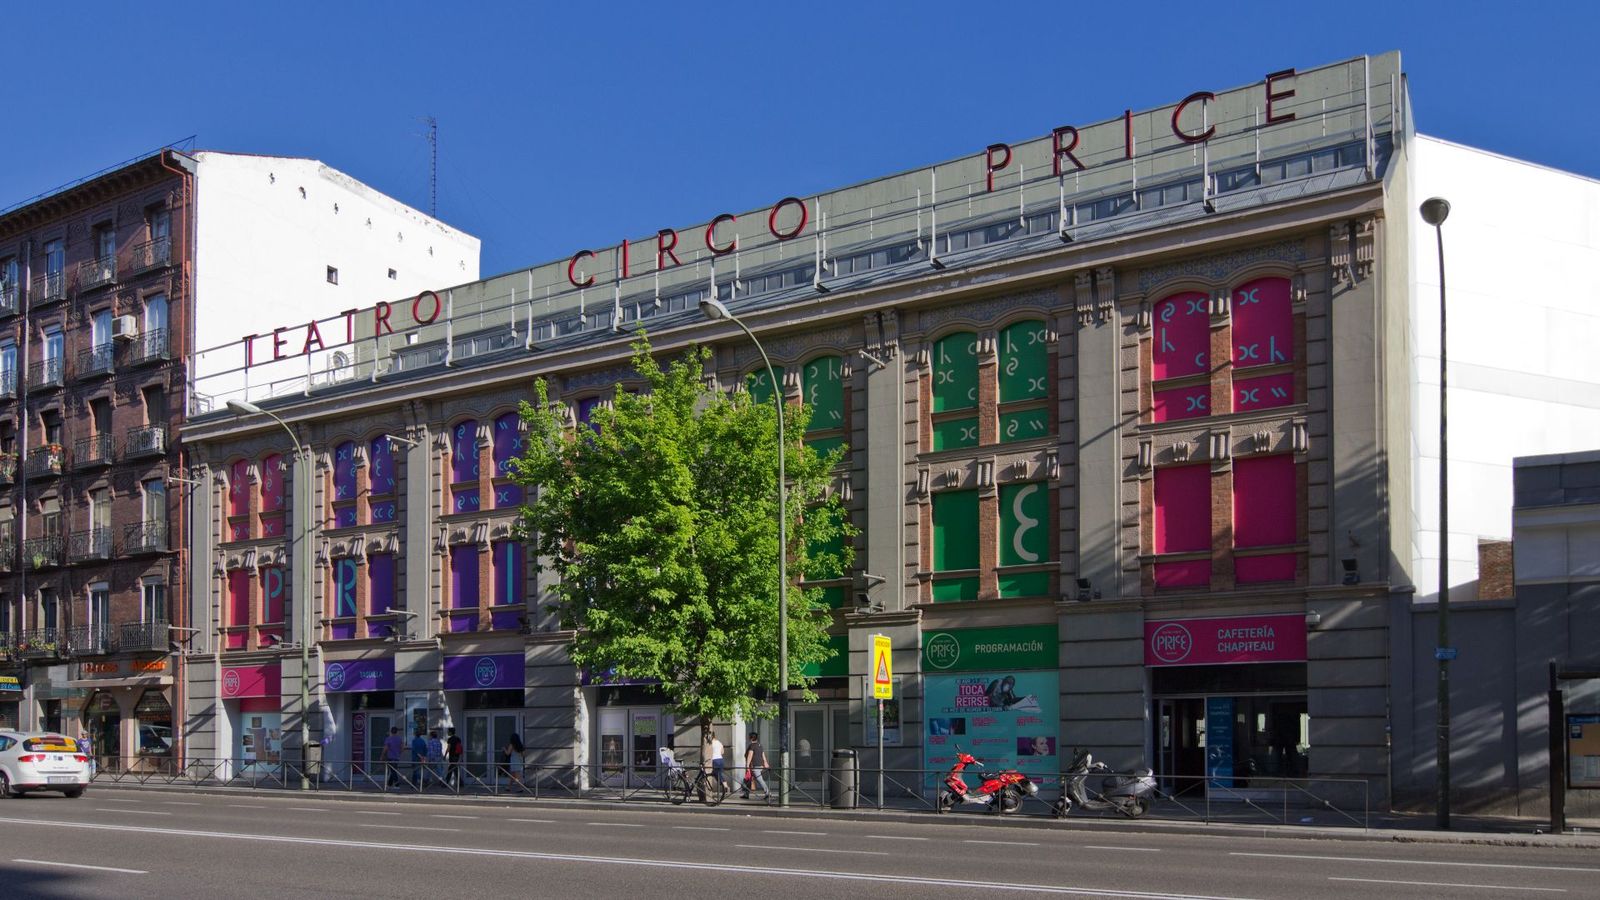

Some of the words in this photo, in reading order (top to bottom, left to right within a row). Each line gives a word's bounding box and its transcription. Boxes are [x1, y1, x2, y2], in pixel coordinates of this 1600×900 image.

[242, 290, 441, 367] TEATRO
[568, 197, 808, 288] CIRCO
[986, 68, 1296, 192] PRICE
[1218, 625, 1275, 639] CAFETERÍA
[975, 640, 1043, 654] PROGRAMACIÓN
[1157, 634, 1187, 651] PRICE
[1218, 641, 1275, 652] CHAPITEAU
[930, 643, 956, 658] PRICE
[960, 685, 984, 695] TOCA
